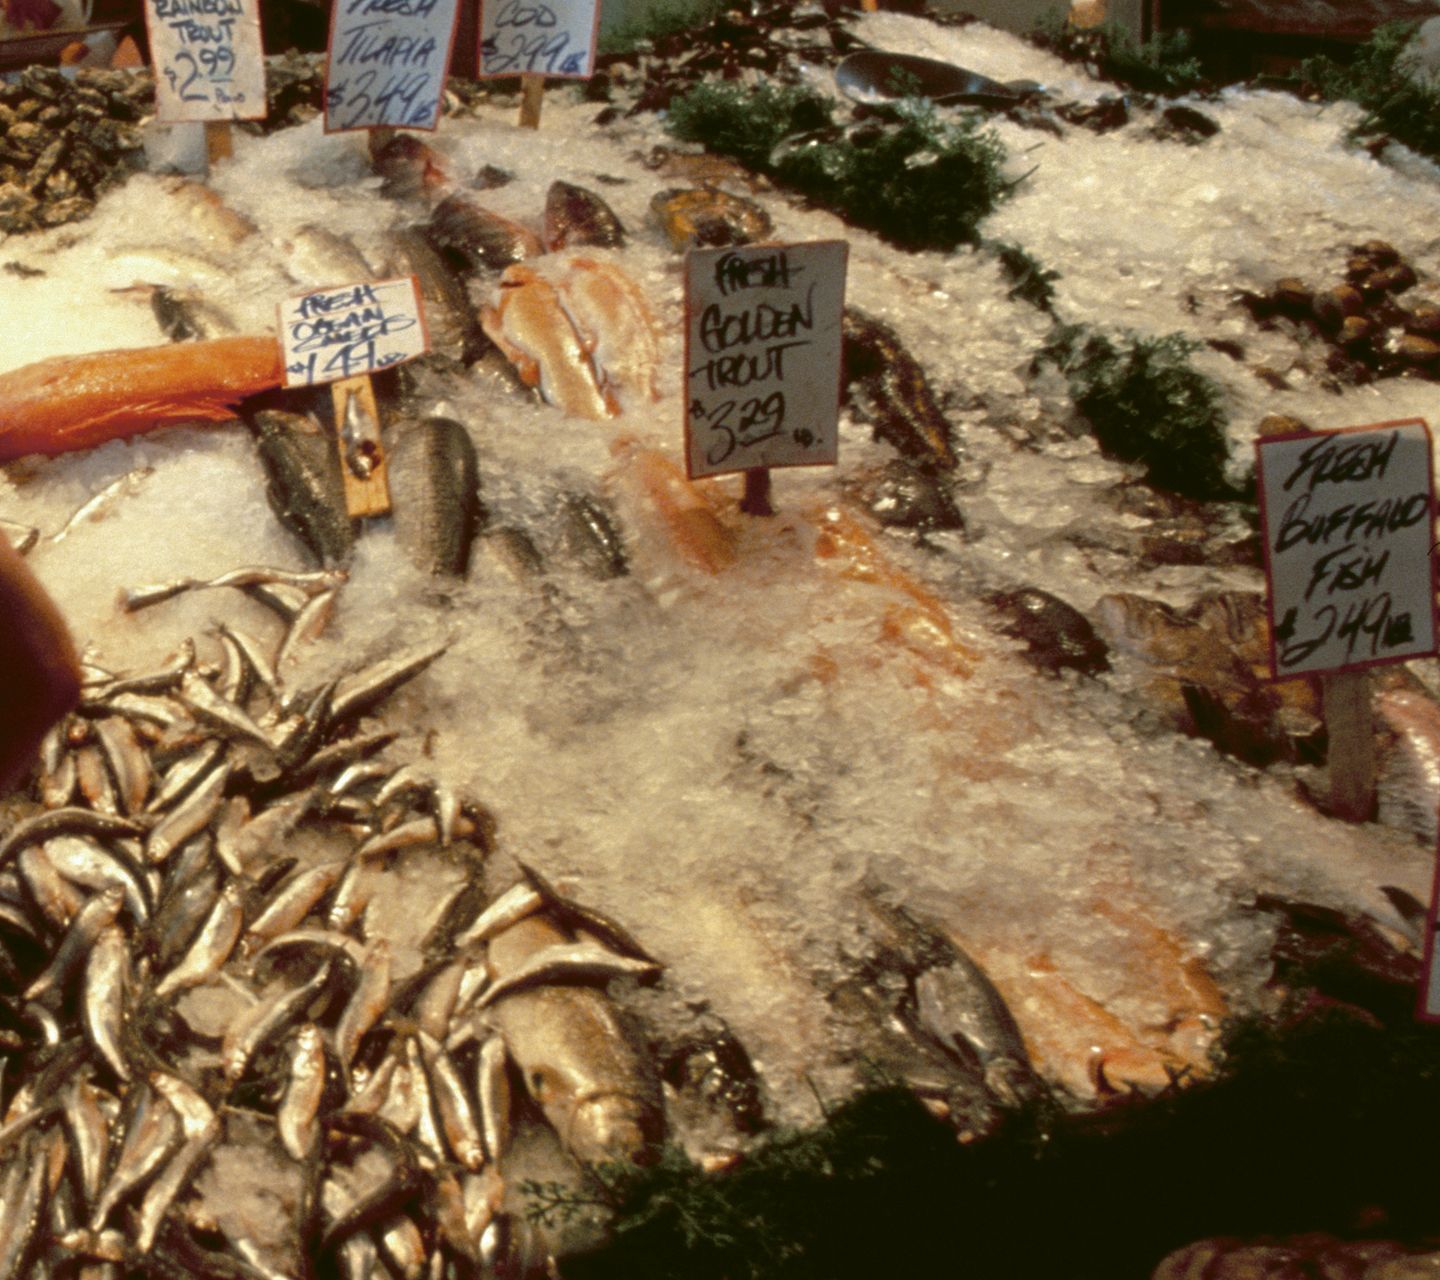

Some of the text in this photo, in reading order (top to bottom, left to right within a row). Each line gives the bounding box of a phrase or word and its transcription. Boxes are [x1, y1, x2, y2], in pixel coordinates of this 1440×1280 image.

[167, 18, 236, 44] TROUT
[495, 0, 558, 28] COD
[714, 251, 806, 297] FRESH
[699, 283, 817, 353] GOLDEN
[688, 340, 812, 391] TROUT
[1283, 431, 1399, 491] FRESH
[1274, 493, 1429, 553] BUFFALO
